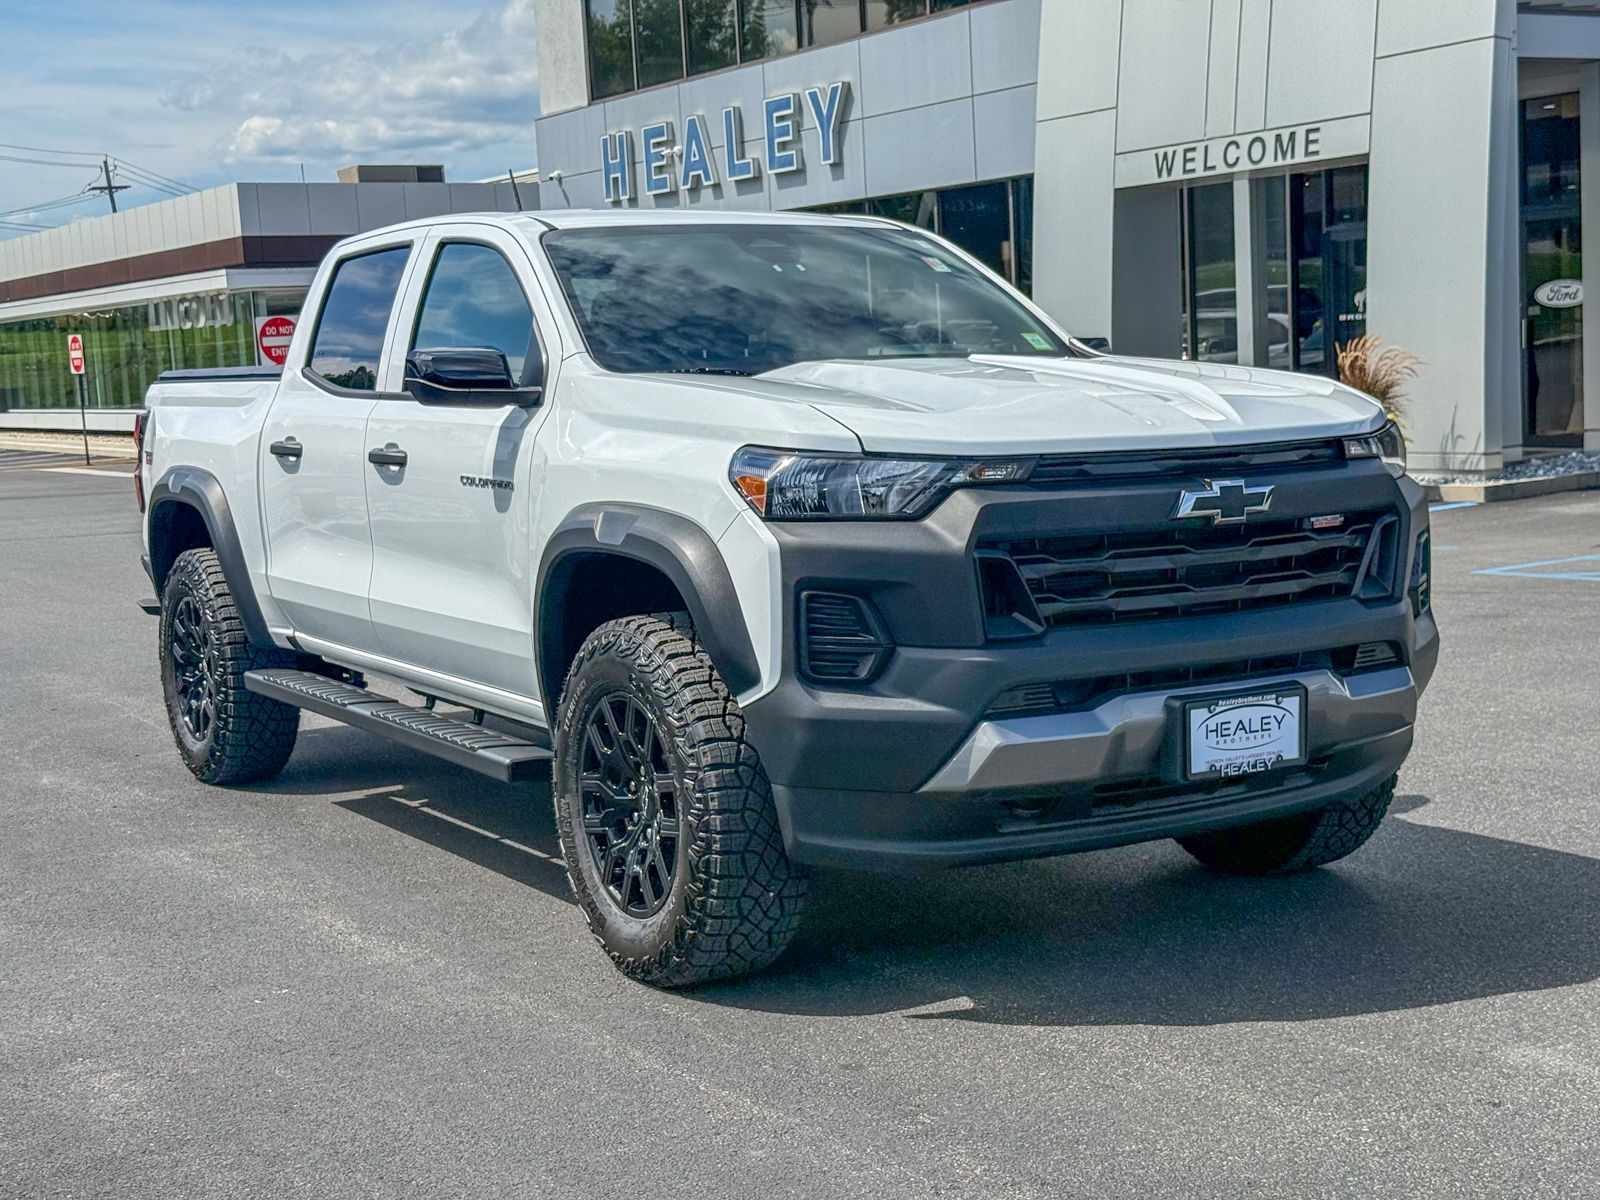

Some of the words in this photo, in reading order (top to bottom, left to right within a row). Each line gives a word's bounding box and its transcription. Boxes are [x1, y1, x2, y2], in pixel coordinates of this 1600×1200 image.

[600, 81, 850, 202] HEALEY
[1154, 127, 1321, 179] WELCOME
[1546, 284, 1580, 302] Ford
[265, 326, 277, 336] DO
[279, 325, 294, 335] NOT
[271, 347, 289, 357] ENT
[1205, 713, 1286, 740] HEALEY
[1215, 732, 1273, 746] BROTHERS
[1221, 758, 1273, 777] HEALEY
